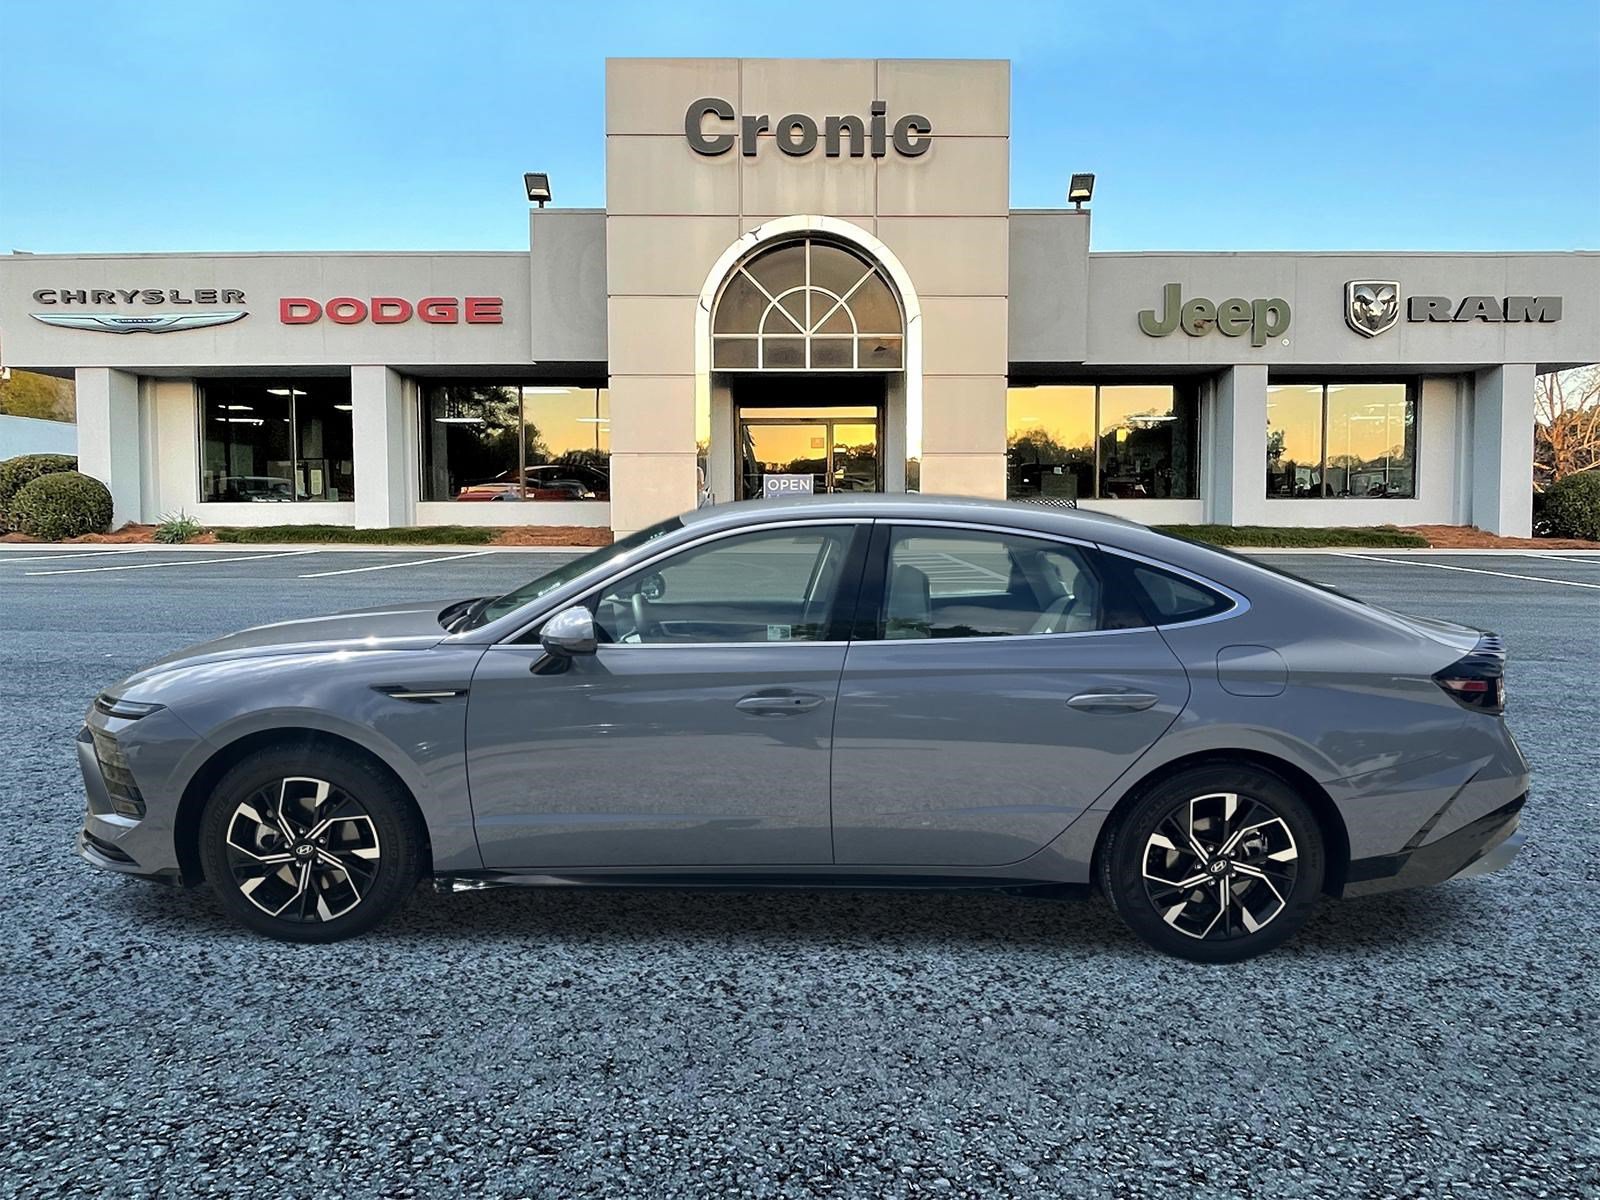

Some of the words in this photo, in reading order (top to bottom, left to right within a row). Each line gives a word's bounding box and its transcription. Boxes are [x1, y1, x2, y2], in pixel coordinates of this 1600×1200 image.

[685, 97, 932, 157] Cronic
[32, 289, 246, 304] CHRYSLER
[1407, 296, 1562, 322] RAM
[280, 297, 503, 324] DODGE
[1138, 283, 1291, 347] Jeep
[768, 479, 810, 490] OPEN
